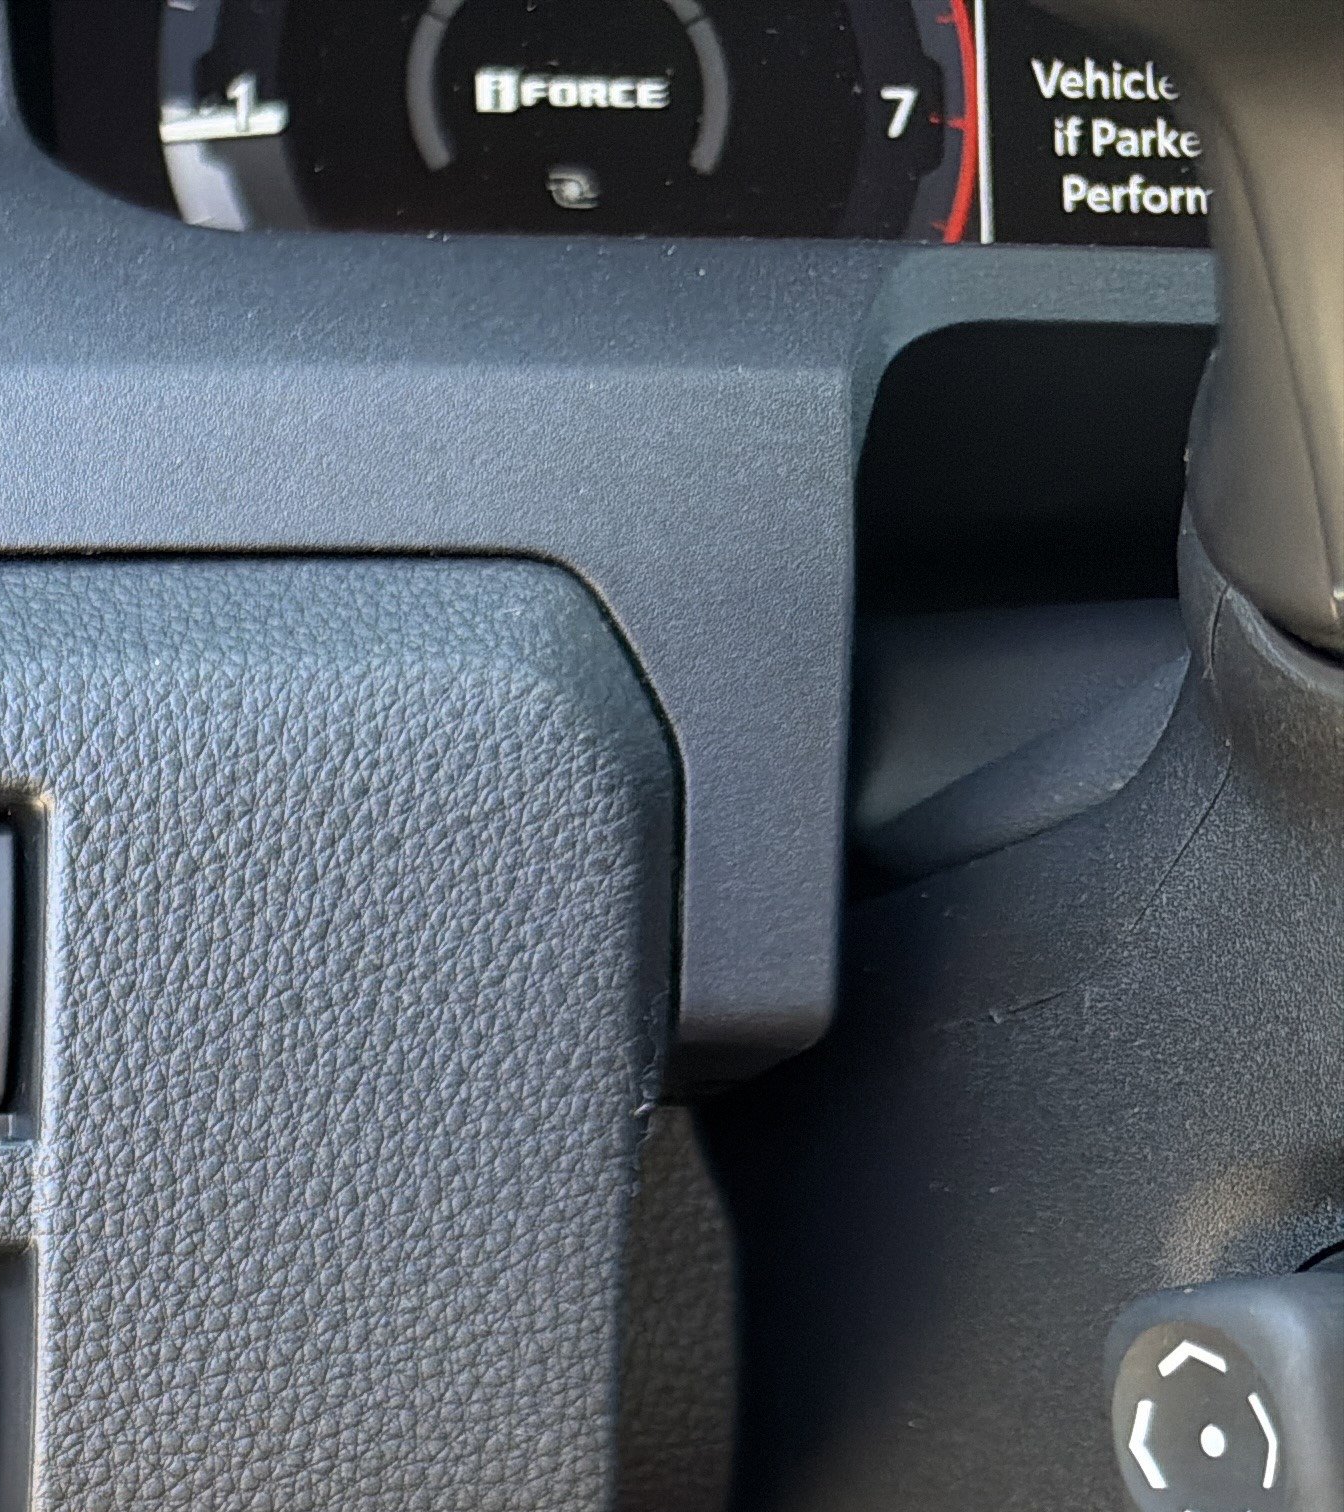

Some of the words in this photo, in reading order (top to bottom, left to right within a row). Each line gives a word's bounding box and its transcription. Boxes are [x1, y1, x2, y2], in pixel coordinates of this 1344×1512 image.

[226, 72, 256, 132] 1
[1030, 57, 1180, 101] Vehicle
[880, 86, 919, 139] 7
[1054, 116, 1083, 157] if
